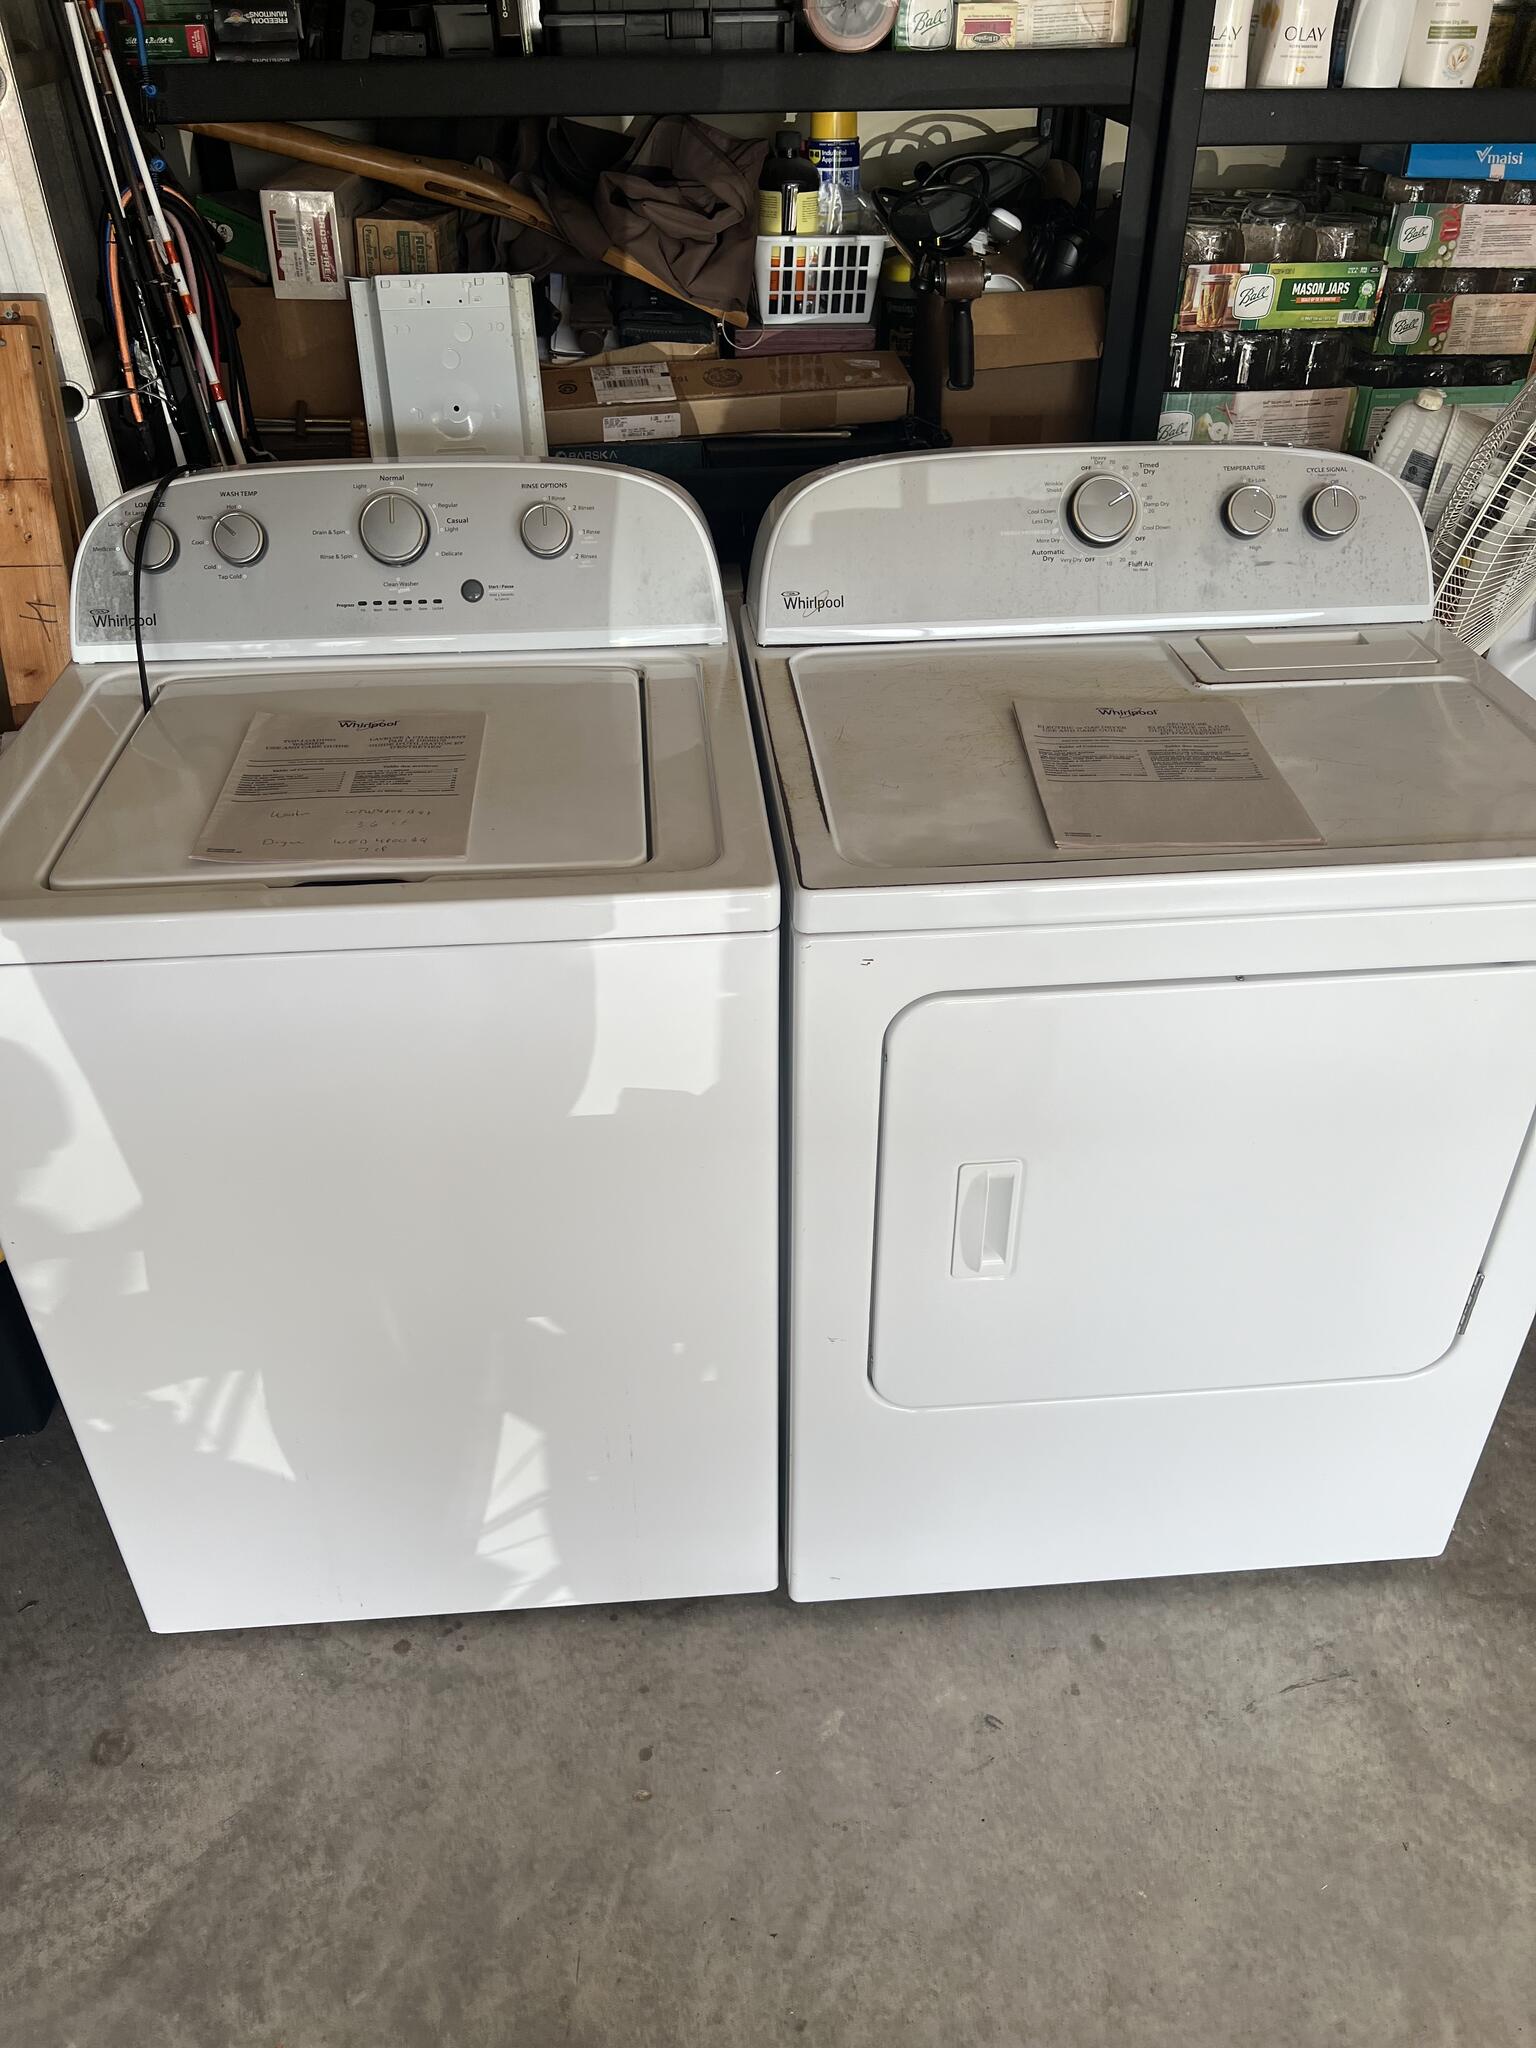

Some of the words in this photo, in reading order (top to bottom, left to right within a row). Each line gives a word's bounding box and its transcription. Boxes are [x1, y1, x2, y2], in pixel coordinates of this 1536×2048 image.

[913, 8, 947, 34] Ball
[1211, 26, 1242, 40] LAY
[1285, 26, 1327, 41] OLAY
[1403, 226, 1429, 242] Ball
[1239, 286, 1270, 306] Ball
[1292, 283, 1325, 295] MASON
[1326, 282, 1350, 295] JARS
[1394, 318, 1419, 334] Ball
[1158, 422, 1187, 440] Ball
[784, 595, 844, 612] Whirlpool
[92, 613, 156, 630] Whirlpool
[1098, 708, 1157, 717] Whirlpool
[338, 720, 399, 730] Whirlpool
